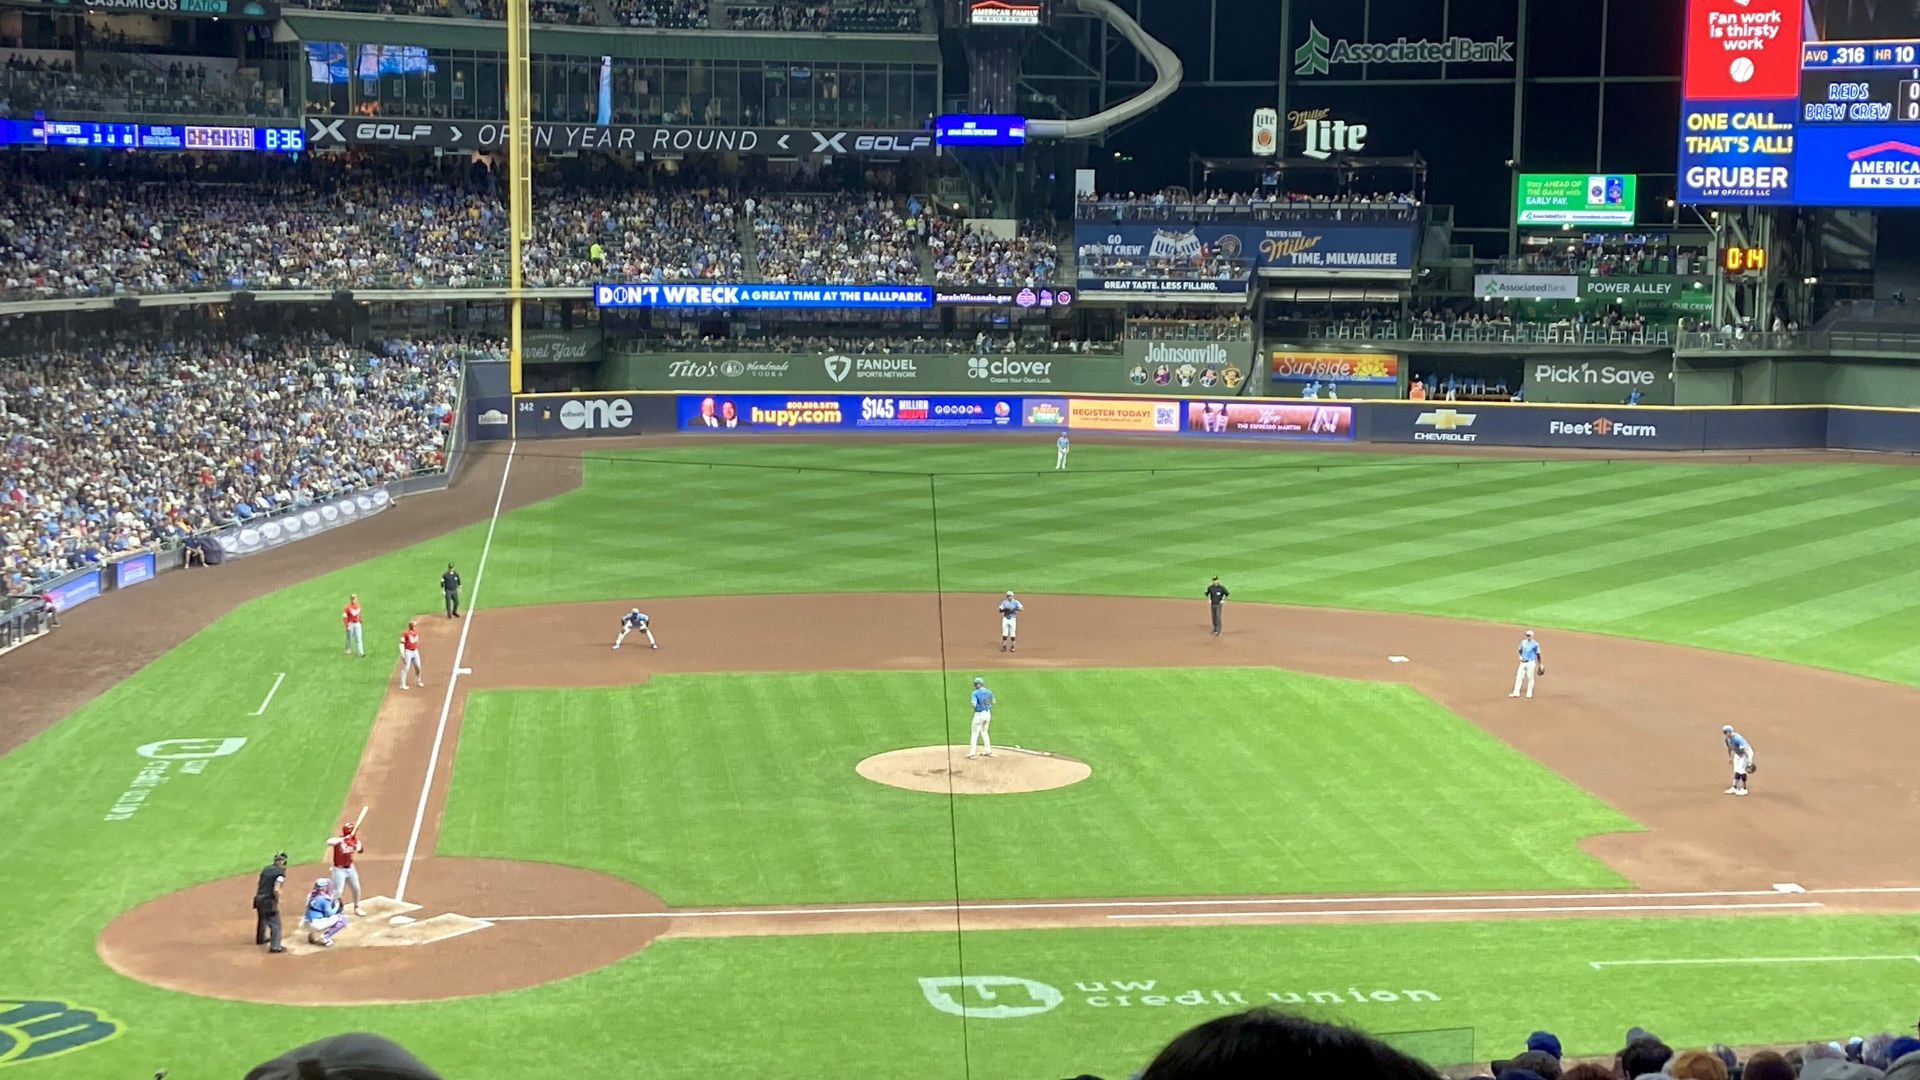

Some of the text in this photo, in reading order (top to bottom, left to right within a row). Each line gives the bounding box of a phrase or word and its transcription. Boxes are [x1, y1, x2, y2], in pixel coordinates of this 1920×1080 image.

[972, 8, 1039, 17] AMERICAN FAMILY
[1709, 10, 1781, 25] Fan work
[1710, 24, 1779, 39] is thirsty
[1723, 38, 1764, 50] work
[1804, 46, 1915, 64] AVG .316 HR 10
[1912, 68, 1919, 79] 1
[1828, 82, 1920, 100] REDS 0
[1287, 107, 1330, 131] Miller
[1805, 102, 1919, 120] BREW CREW 0
[1255, 114, 1275, 128] Lite
[1687, 112, 1793, 130] ONE CALL...
[265, 129, 302, 148] 8:36
[356, 123, 433, 140] GOLF
[566, 127, 634, 148] YEAR
[652, 129, 758, 151] ROUND
[1303, 119, 1367, 160] Lite
[855, 136, 931, 151] GOLF
[1686, 136, 1793, 154] THAT'S ALL!
[1686, 166, 1788, 188] GRUBER
[1565, 188, 1582, 196] with
[1526, 197, 1568, 205] EARLY PAY.
[1107, 234, 1122, 244] GO
[1114, 245, 1142, 255] CREW
[1259, 235, 1322, 262] Miller
[1292, 252, 1397, 266] TIME, MILWAUKEE
[1726, 247, 1764, 270] 0:14
[1104, 281, 1218, 290] GREAT TASTE. LESS FILLING.
[1587, 282, 1672, 294] POWER ALLEY
[599, 287, 927, 304] DON'T WRECK A GREAT TIME AT THE BALLPARK.
[522, 342, 587, 361] rrel Yard
[1144, 342, 1227, 363] Johnsonville
[668, 358, 790, 378] Tito's Handmade
[857, 358, 917, 370] FANDUEL
[990, 357, 1052, 375] clover
[1279, 355, 1351, 377] Surfside
[1601, 366, 1656, 385] Save
[519, 402, 534, 412] 342
[862, 397, 929, 421] $145 MILLION
[1073, 409, 1150, 418] REGISTER TODAY!
[752, 406, 842, 427] hupy.com
[1415, 432, 1477, 442] CHEVROLET
[1550, 421, 1656, 436] Fleet Farm
[1075, 979, 1158, 993] uw
[1086, 986, 1443, 1008] credit union
